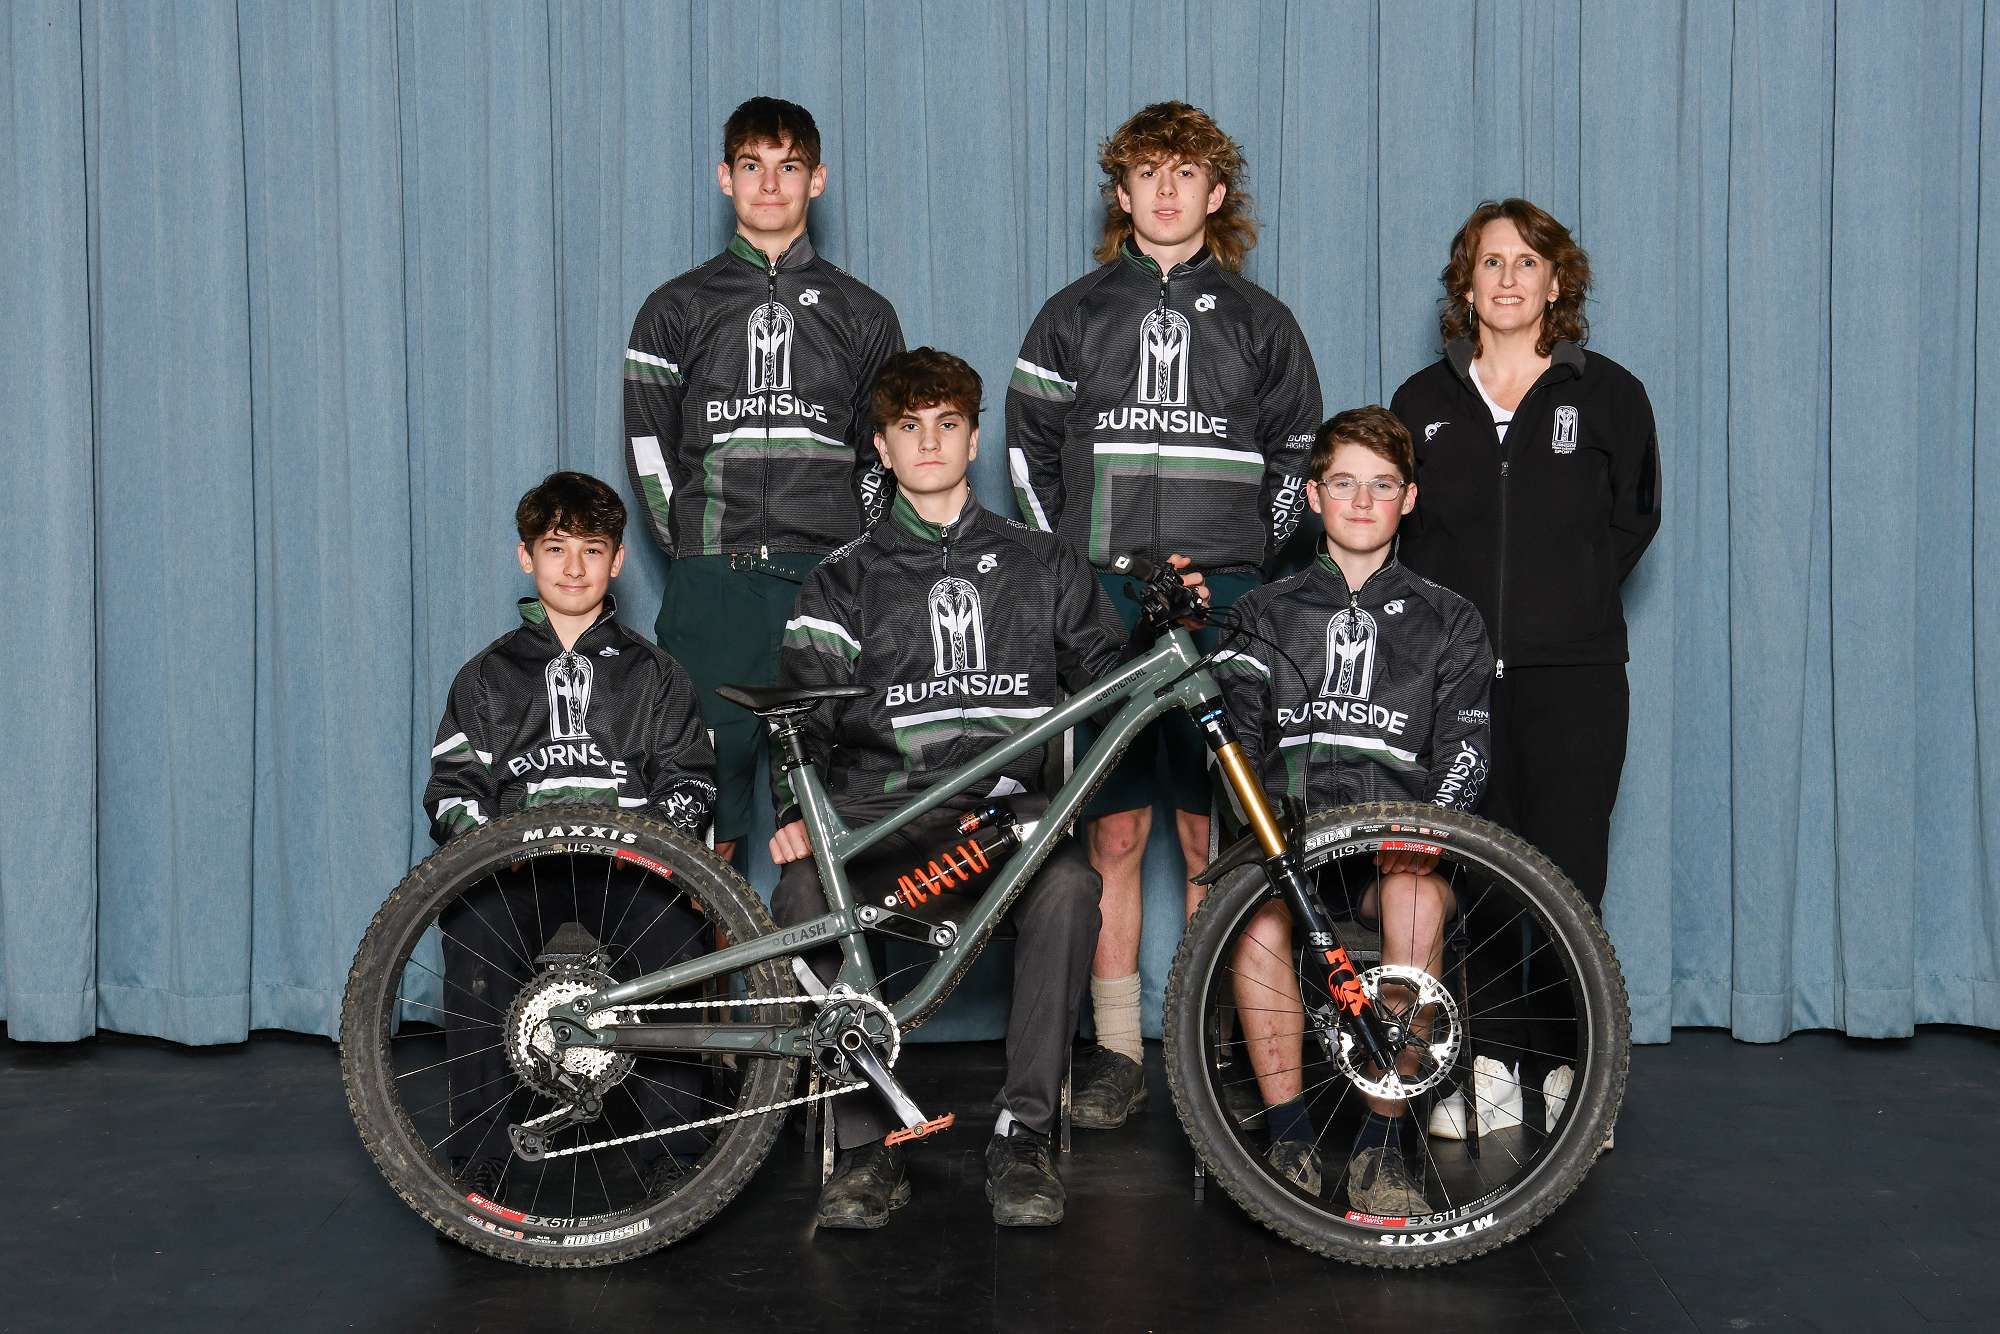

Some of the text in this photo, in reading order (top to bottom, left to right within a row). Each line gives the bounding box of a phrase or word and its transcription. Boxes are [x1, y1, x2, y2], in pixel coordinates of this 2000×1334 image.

[706, 394, 828, 423] BURNSIDE
[1094, 407, 1228, 438] BURNSIDE
[885, 673, 1029, 706] BURNSIDE
[1277, 700, 1409, 735] BURNSIDE
[522, 825, 639, 845] MAXXIS
[567, 843, 618, 855] EX511
[1332, 843, 1384, 860] EX511
[1403, 842, 1424, 850] SWISS
[782, 922, 827, 947] CLASH
[1308, 931, 1334, 946] 36
[1324, 947, 1372, 1017] FOX
[472, 1196, 504, 1215] DT SWISS
[522, 1215, 575, 1229] EX511
[1362, 1216, 1384, 1225] SWISS
[1406, 1209, 1456, 1227] EX511
[1380, 1213, 1497, 1246] MAXXIS
